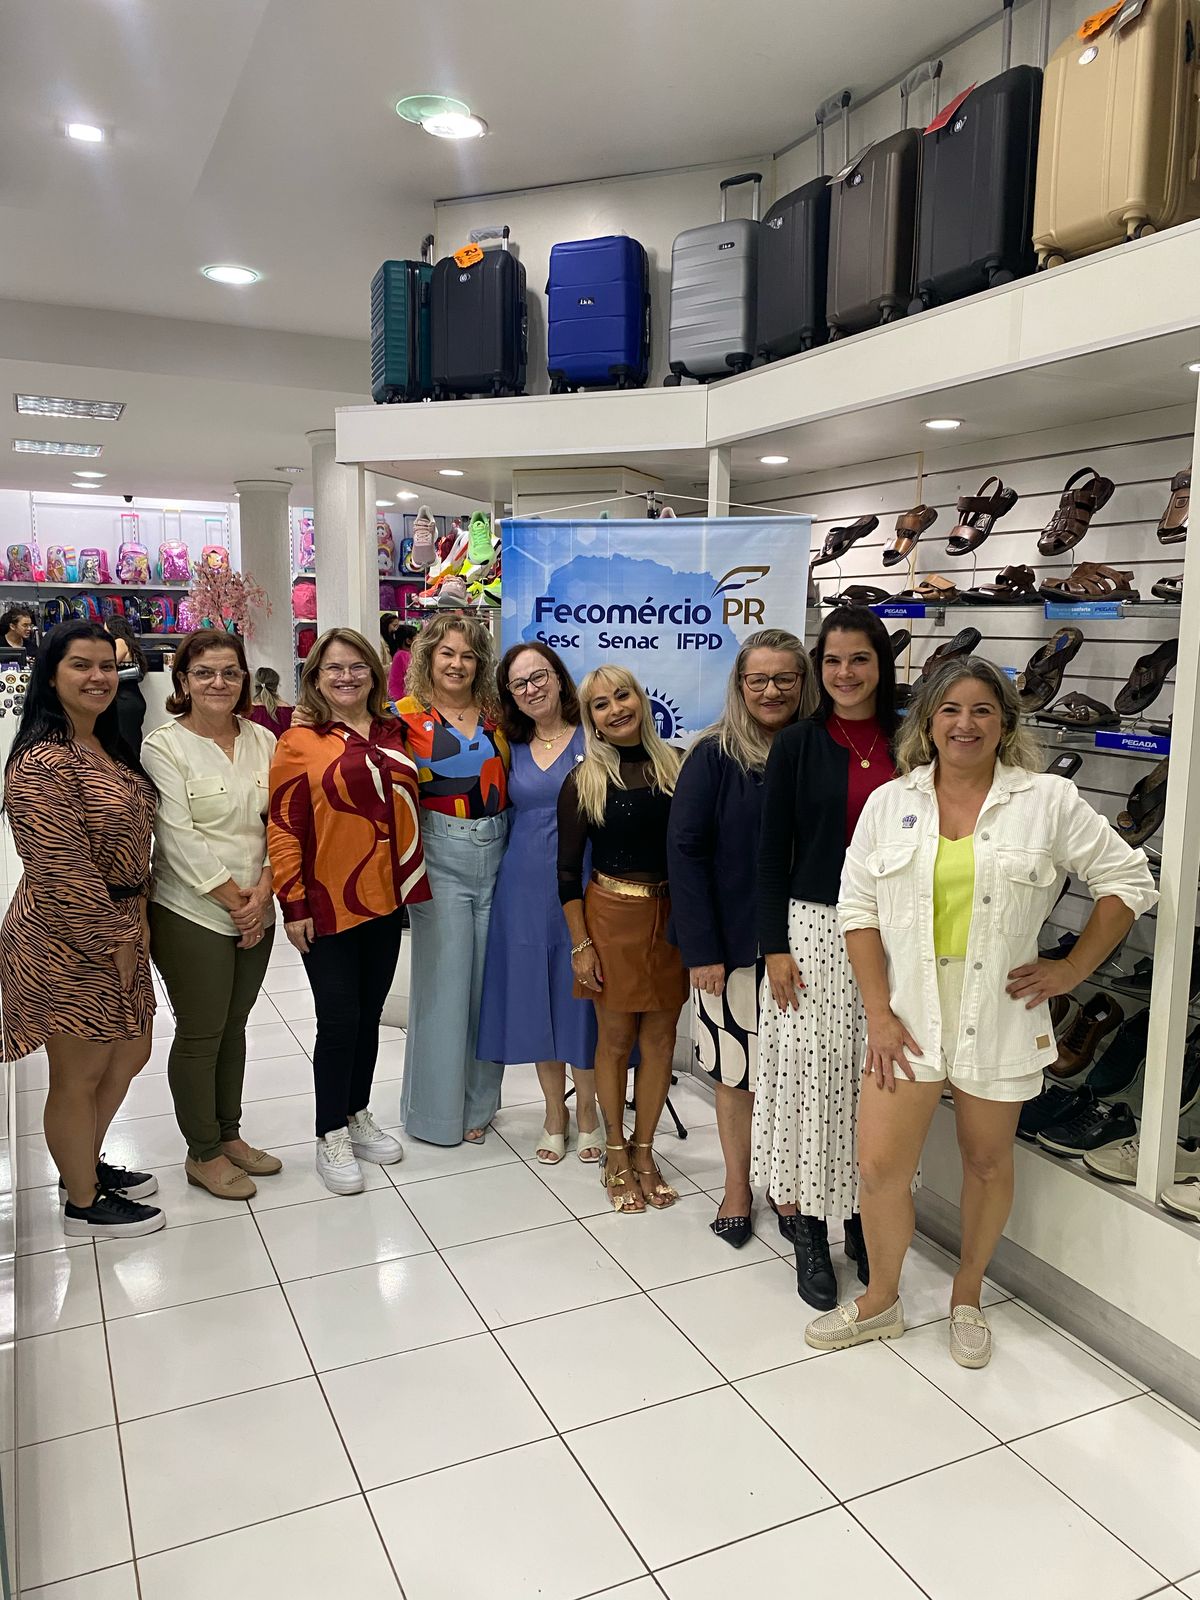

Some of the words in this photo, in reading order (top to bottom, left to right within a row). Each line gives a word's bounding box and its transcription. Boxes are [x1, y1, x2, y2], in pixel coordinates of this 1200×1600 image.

[535, 596, 712, 625] Fecomércio
[722, 598, 766, 625] PR
[536, 630, 580, 648] Sesc
[598, 631, 659, 649] Senac
[677, 632, 723, 650] IFPD
[1122, 739, 1157, 748] PEGADA
